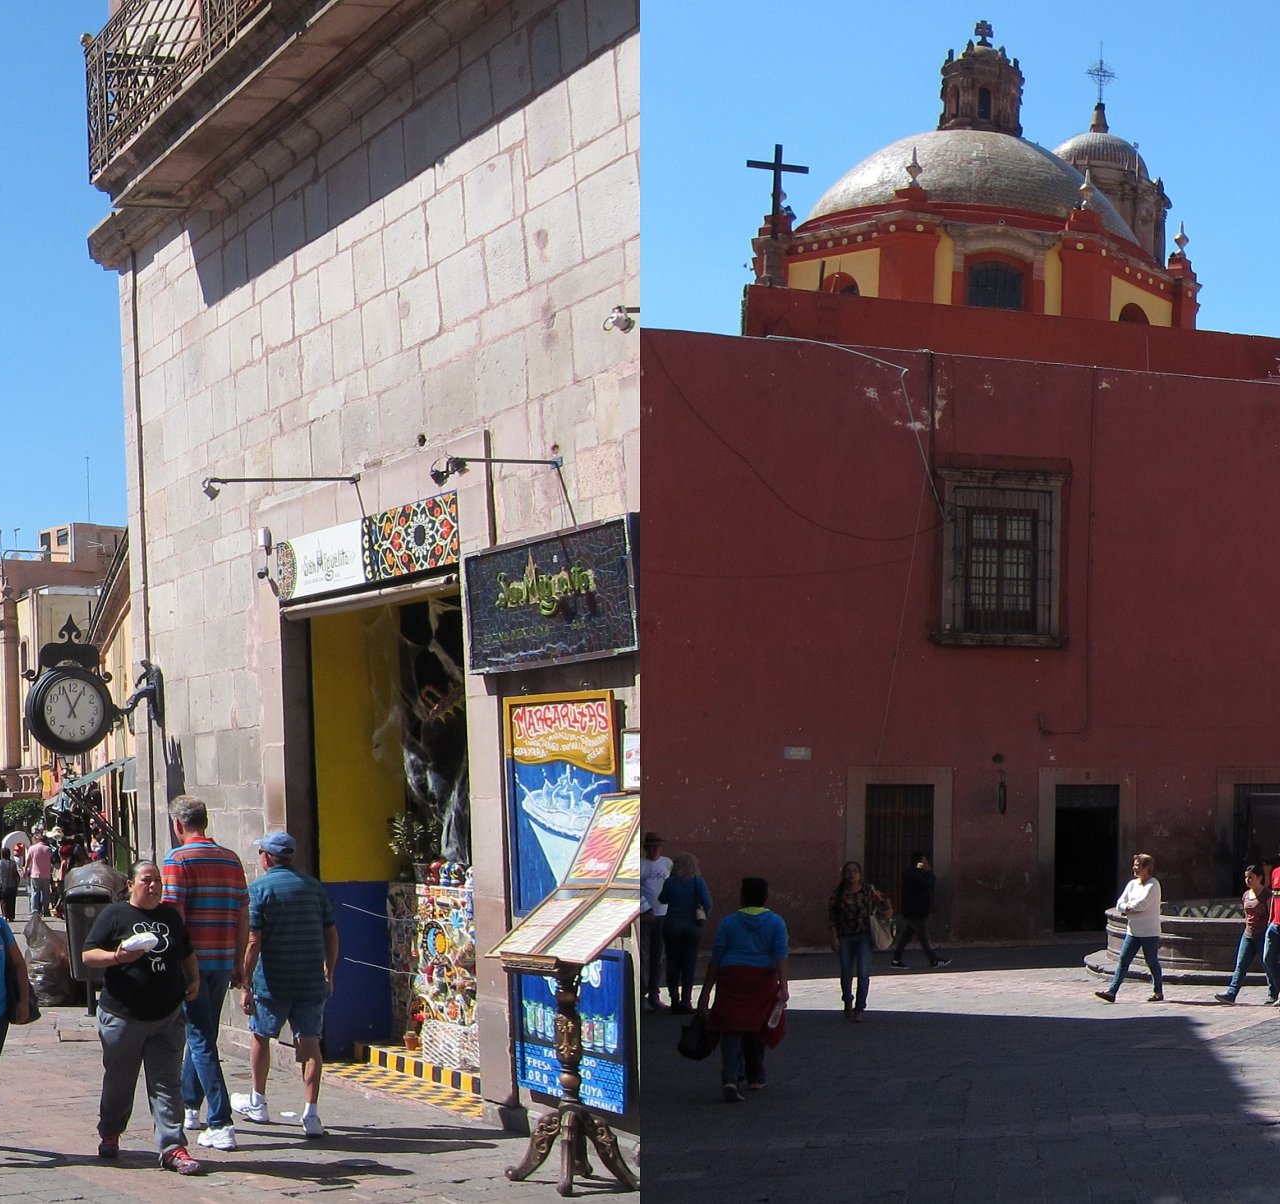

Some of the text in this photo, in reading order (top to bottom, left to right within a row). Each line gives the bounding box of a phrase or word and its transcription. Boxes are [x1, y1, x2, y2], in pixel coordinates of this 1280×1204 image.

[69, 683, 78, 693] 12
[49, 694, 59, 704] 10
[89, 695, 95, 705] 2
[47, 705, 53, 715] 9
[93, 706, 99, 716] 3
[50, 717, 56, 726] 8
[88, 718, 95, 728] 4
[59, 725, 65, 735] 7
[80, 726, 86, 736] 5
[526, 1058, 553, 1072] FRESA
